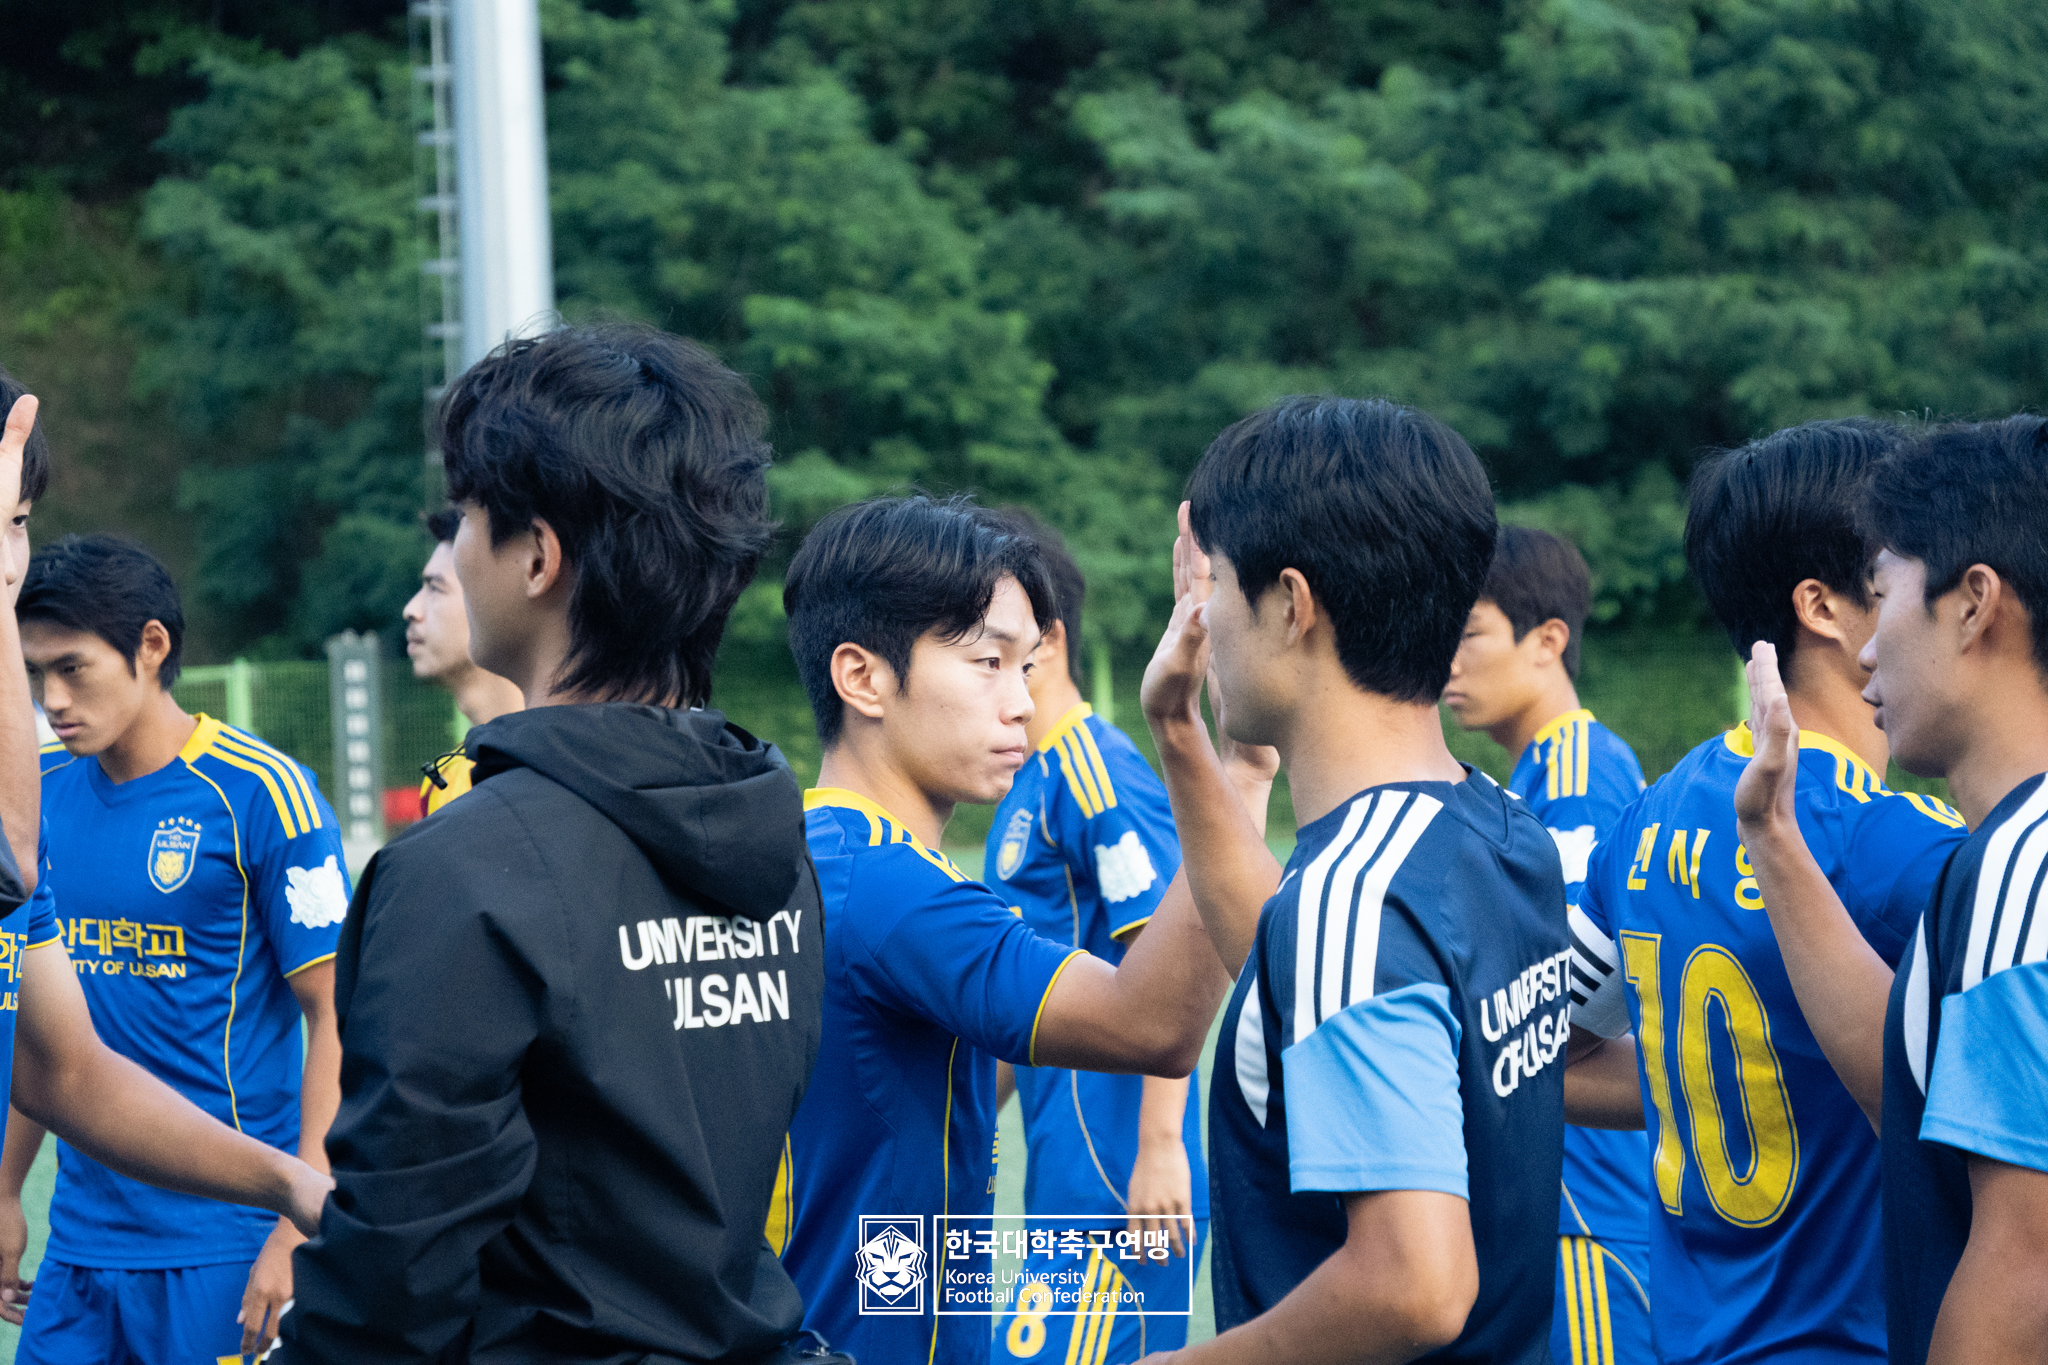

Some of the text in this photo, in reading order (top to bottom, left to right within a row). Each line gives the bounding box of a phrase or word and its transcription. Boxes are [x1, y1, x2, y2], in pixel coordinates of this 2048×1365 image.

[102, 960, 124, 976] OF
[618, 909, 802, 971] UNIVERSITY
[1619, 929, 1799, 1229] 10
[1006, 1282, 1053, 1358] 8
